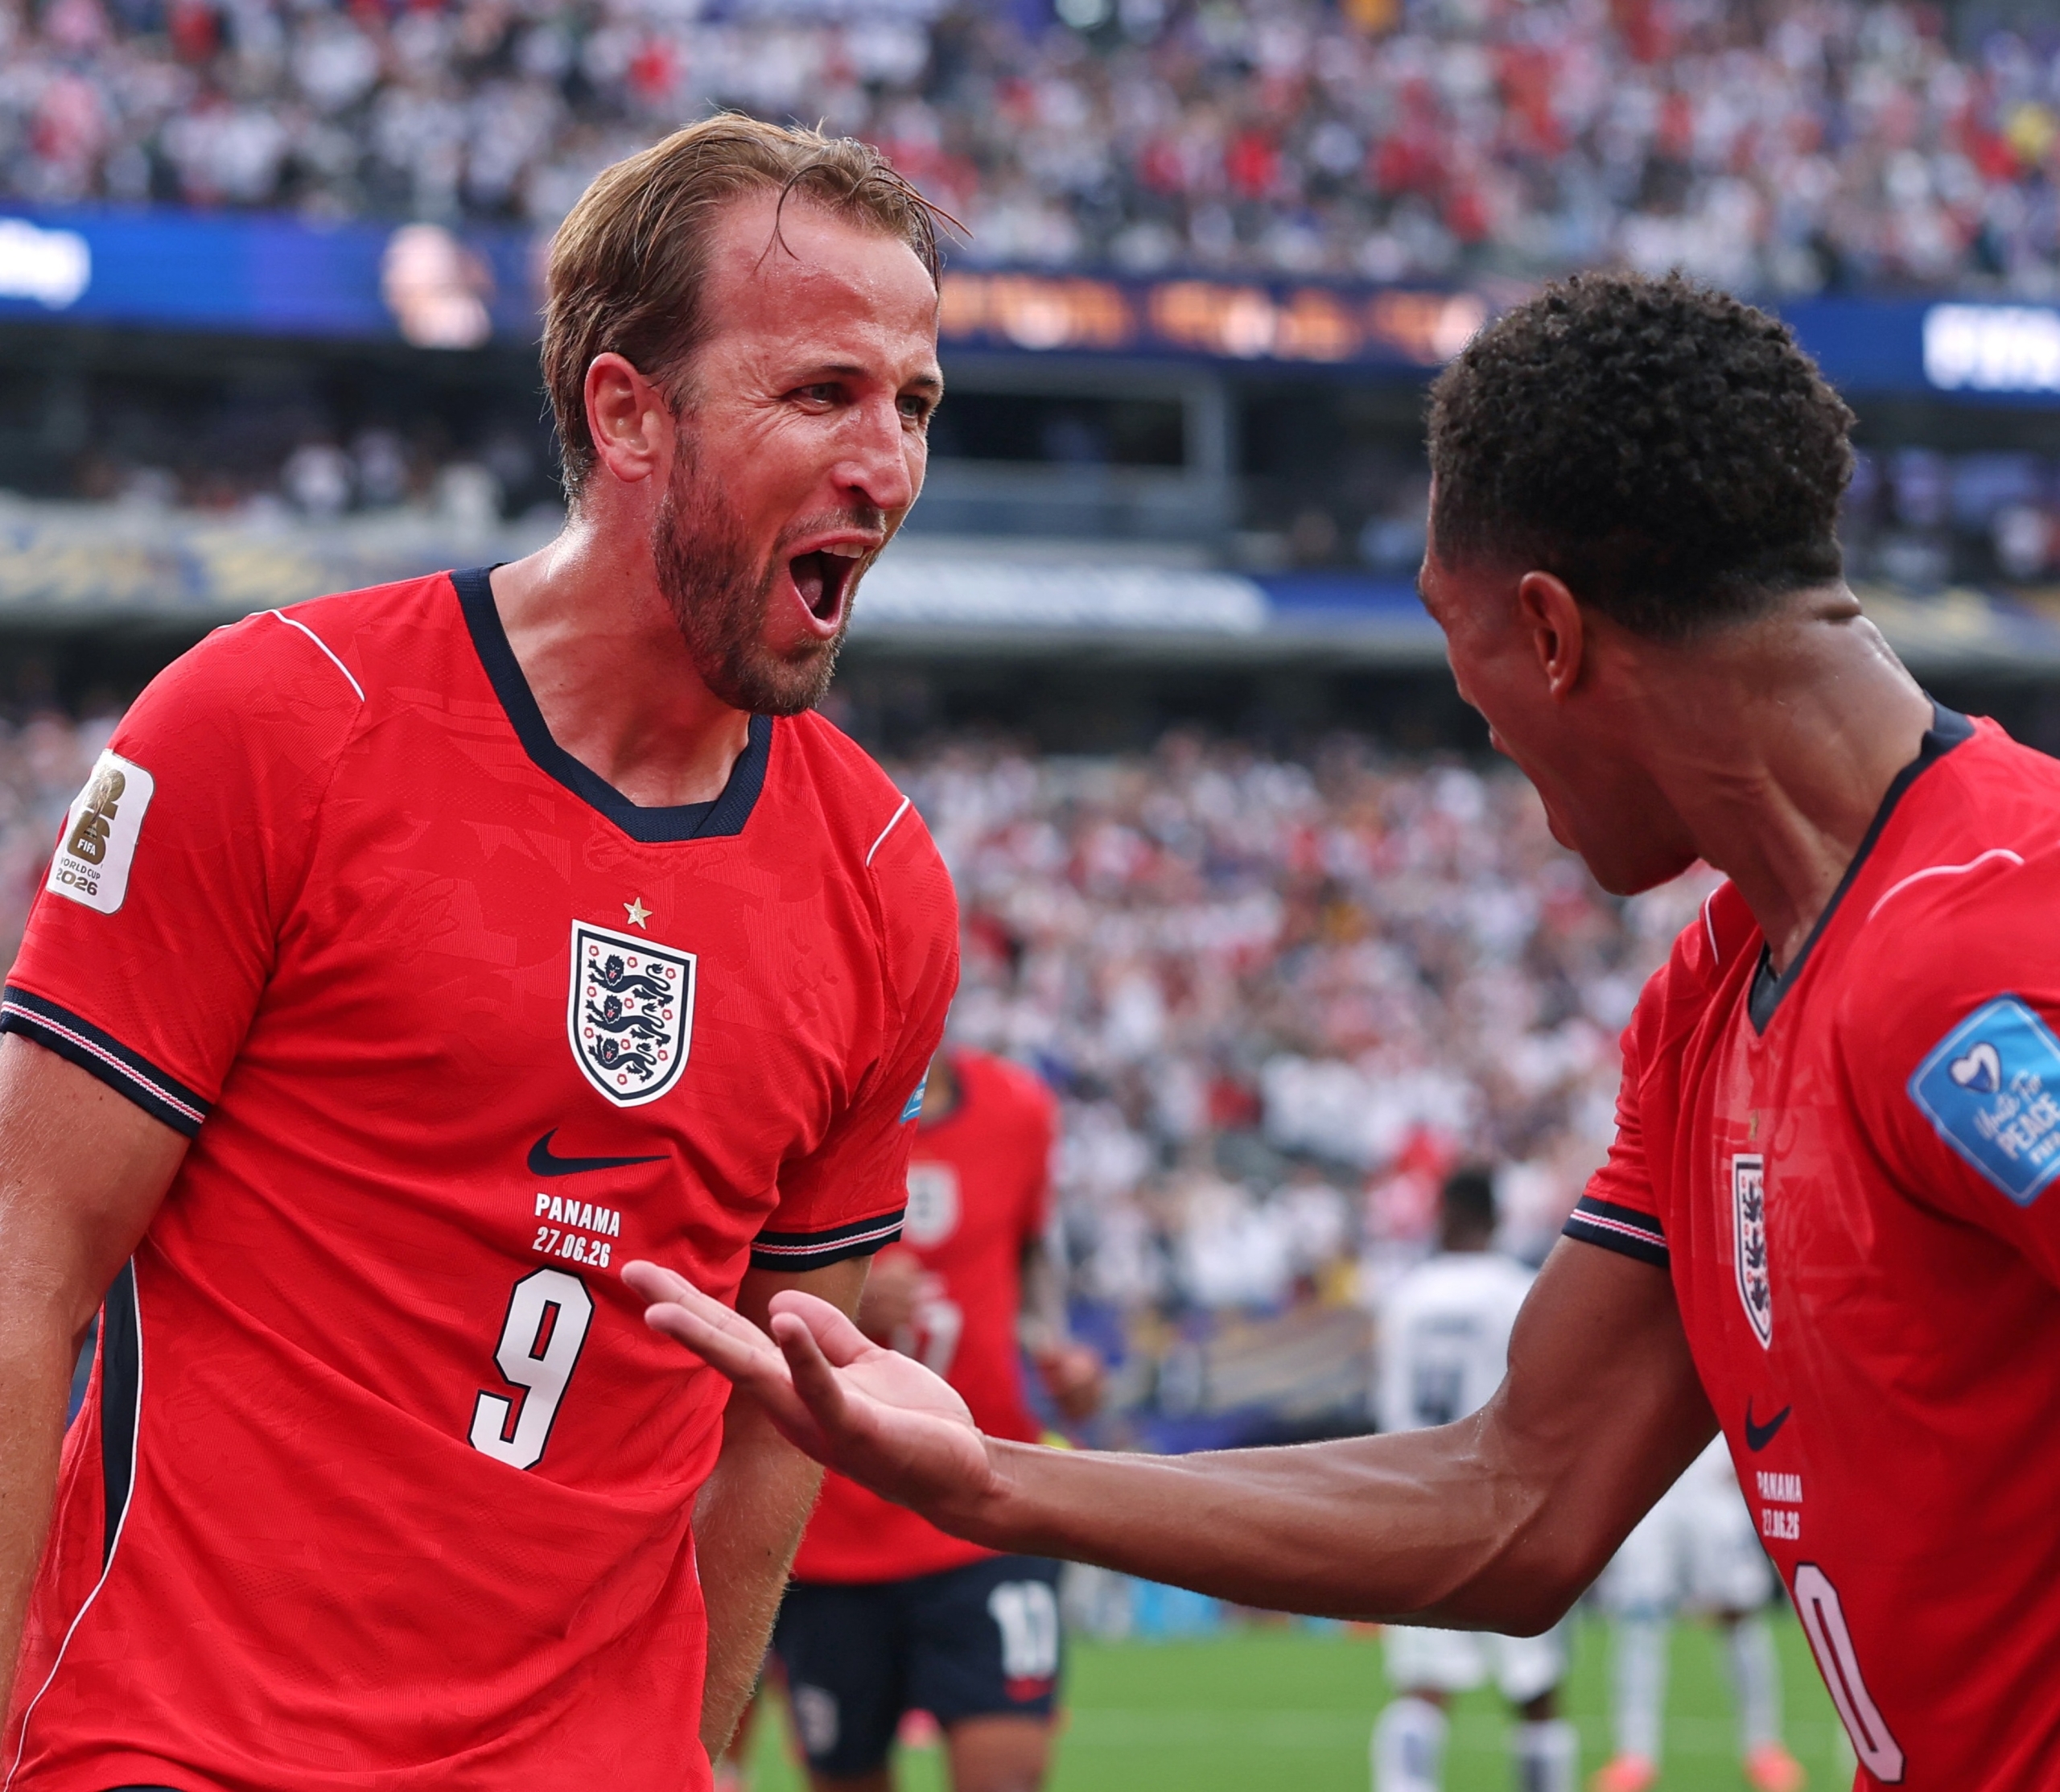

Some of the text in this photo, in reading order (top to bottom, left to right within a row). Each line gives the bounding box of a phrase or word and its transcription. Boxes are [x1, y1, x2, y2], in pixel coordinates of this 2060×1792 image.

[77, 838, 96, 856] FIFA
[56, 867, 98, 896] 2026
[87, 868, 101, 880] CUP
[534, 1193, 620, 1238] PANAMA
[532, 1226, 612, 1268] 27.06.26
[467, 1264, 596, 1471] 9
